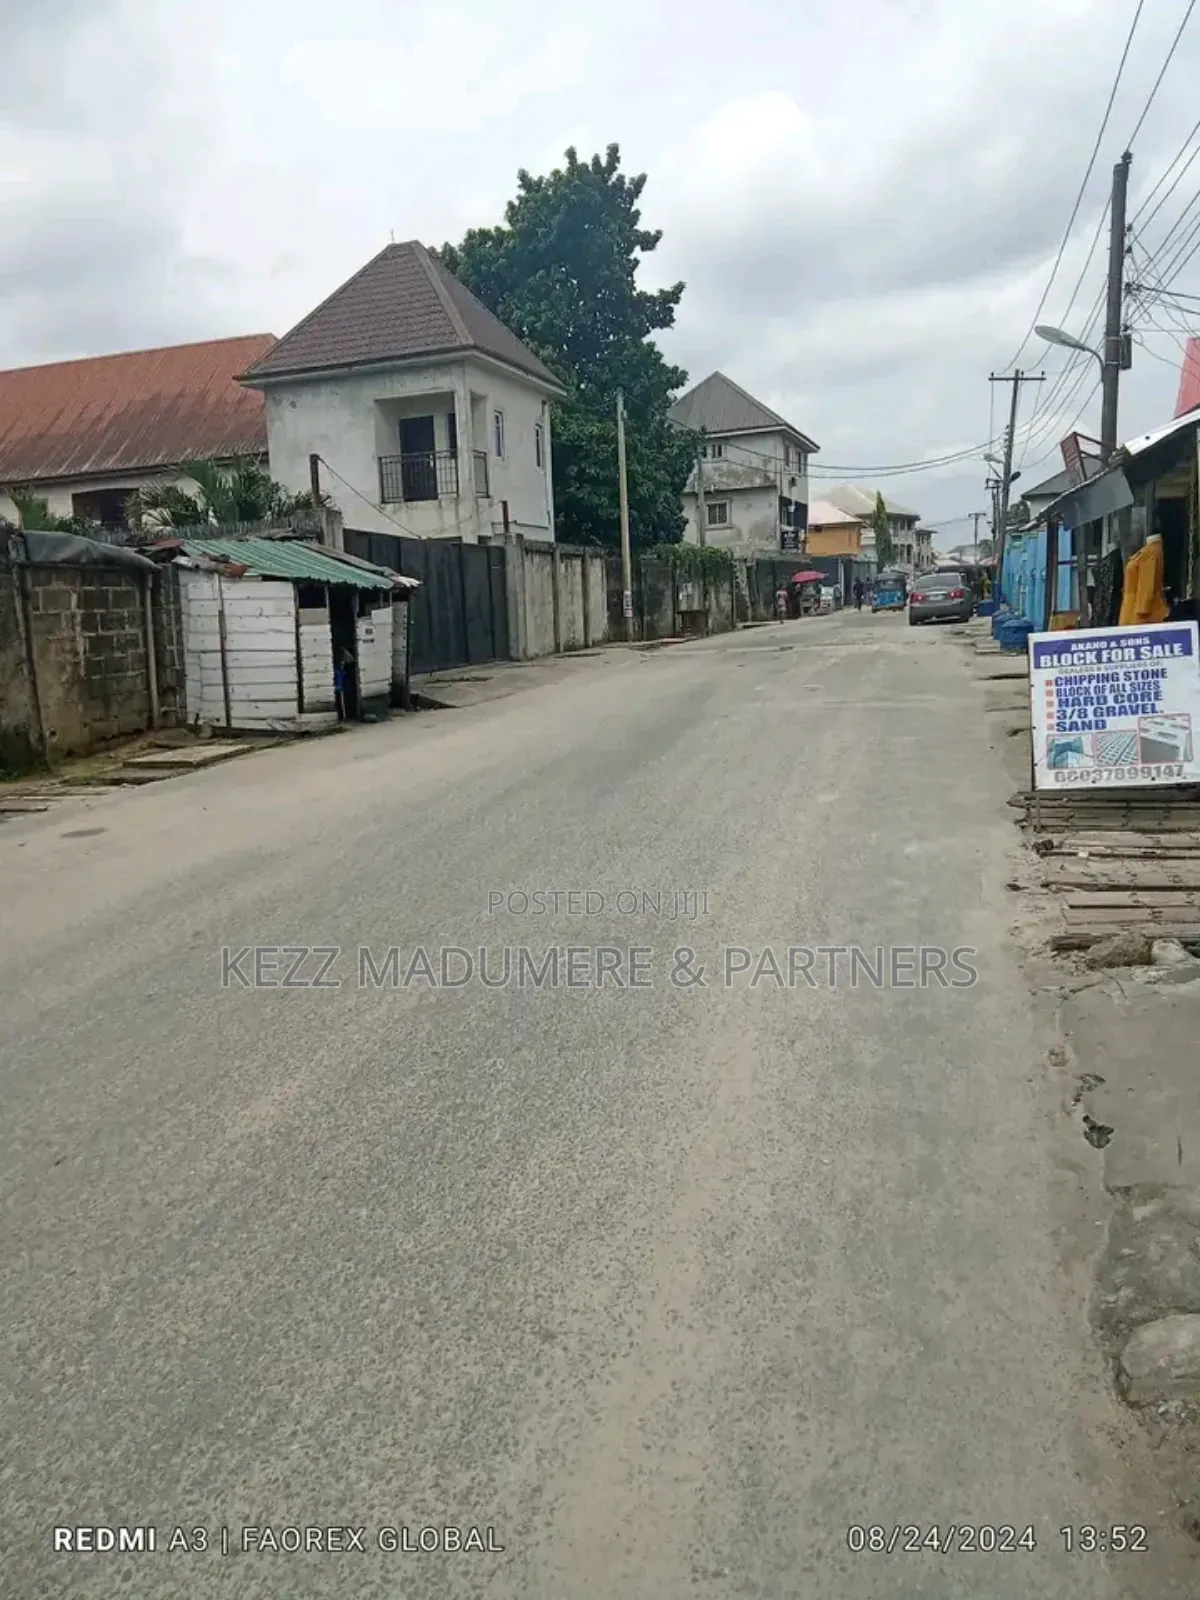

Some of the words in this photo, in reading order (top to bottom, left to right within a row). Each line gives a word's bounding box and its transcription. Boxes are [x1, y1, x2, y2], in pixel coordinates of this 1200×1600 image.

[1120, 637, 1151, 648] SONS
[1040, 651, 1098, 668] BLOCK
[1101, 648, 1135, 662] FOR
[1140, 643, 1183, 658] SALE
[1054, 672, 1120, 687] CHIPPING
[1123, 668, 1168, 681] STONE
[1056, 686, 1092, 698] BLOCK
[1093, 684, 1107, 695] OF
[1109, 683, 1128, 694] ALL
[1129, 680, 1161, 693] SIZES
[1058, 695, 1108, 708] HARD
[1113, 690, 1164, 705] CORE
[1056, 708, 1088, 720] 3/8
[1056, 719, 1108, 732] SAND
